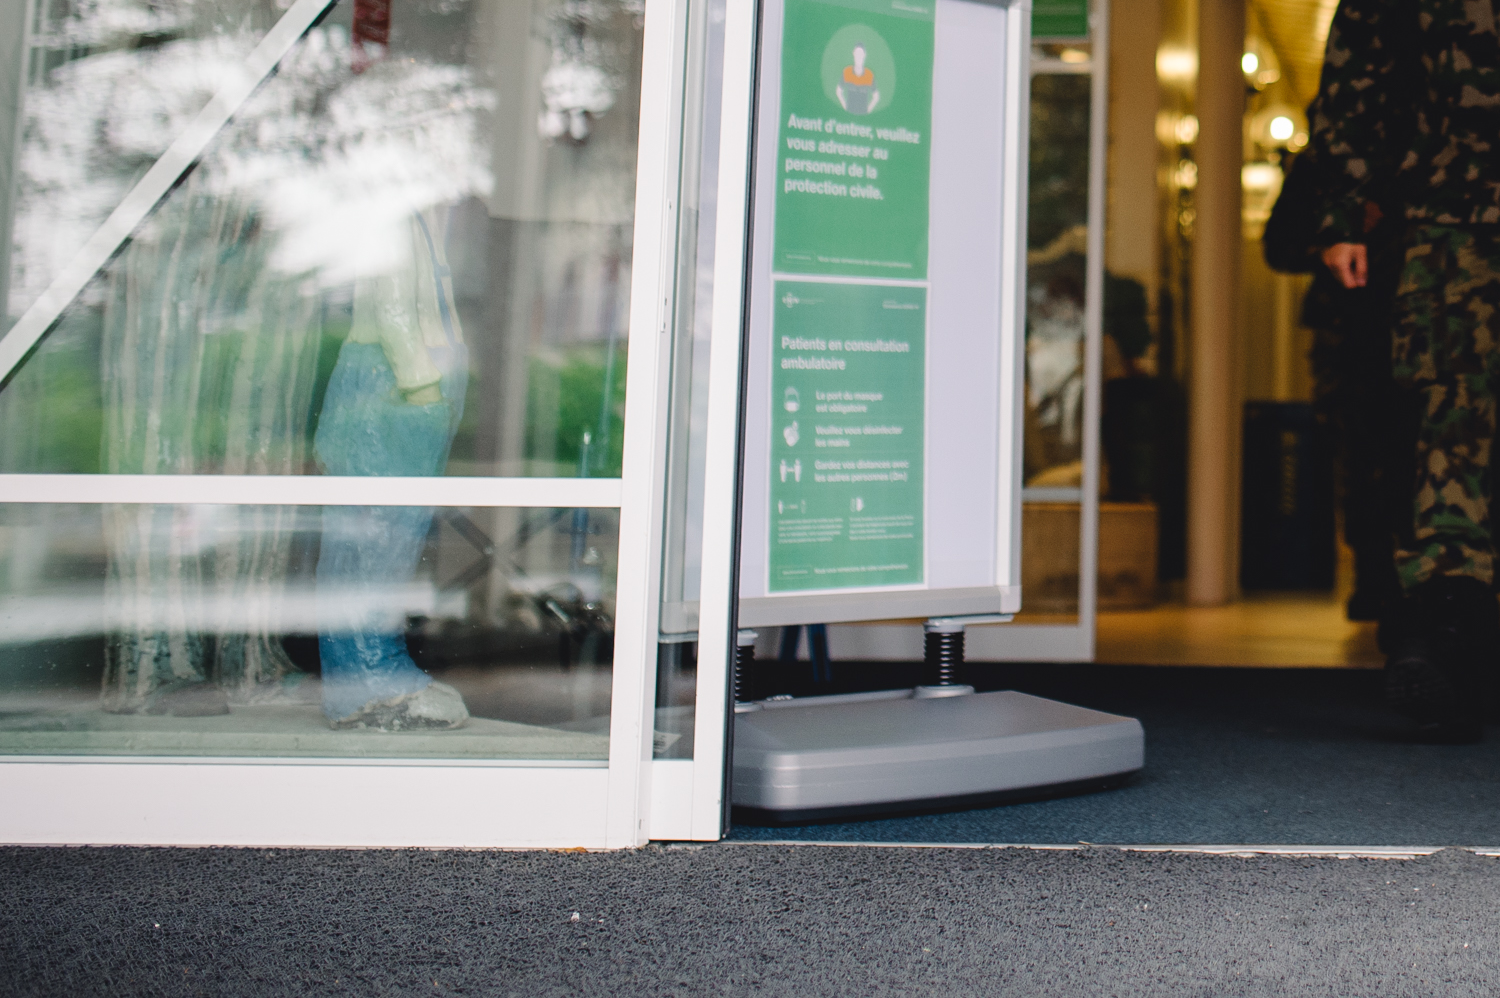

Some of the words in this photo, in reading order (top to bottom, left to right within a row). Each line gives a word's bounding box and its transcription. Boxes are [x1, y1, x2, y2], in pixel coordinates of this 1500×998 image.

[788, 113, 822, 132] Avant
[825, 119, 874, 140] d'entrer,
[876, 127, 920, 144] veuillez
[787, 138, 816, 152] vous
[818, 141, 870, 158] adresser
[873, 148, 888, 160] au
[785, 158, 846, 176] personnel
[848, 163, 863, 178] de
[866, 165, 877, 179] la
[784, 179, 847, 196] protection
[850, 184, 884, 200] civile.
[781, 336, 826, 350] Patients
[828, 340, 842, 351] en
[844, 339, 909, 352] consultation
[781, 357, 846, 370] ambulatoire
